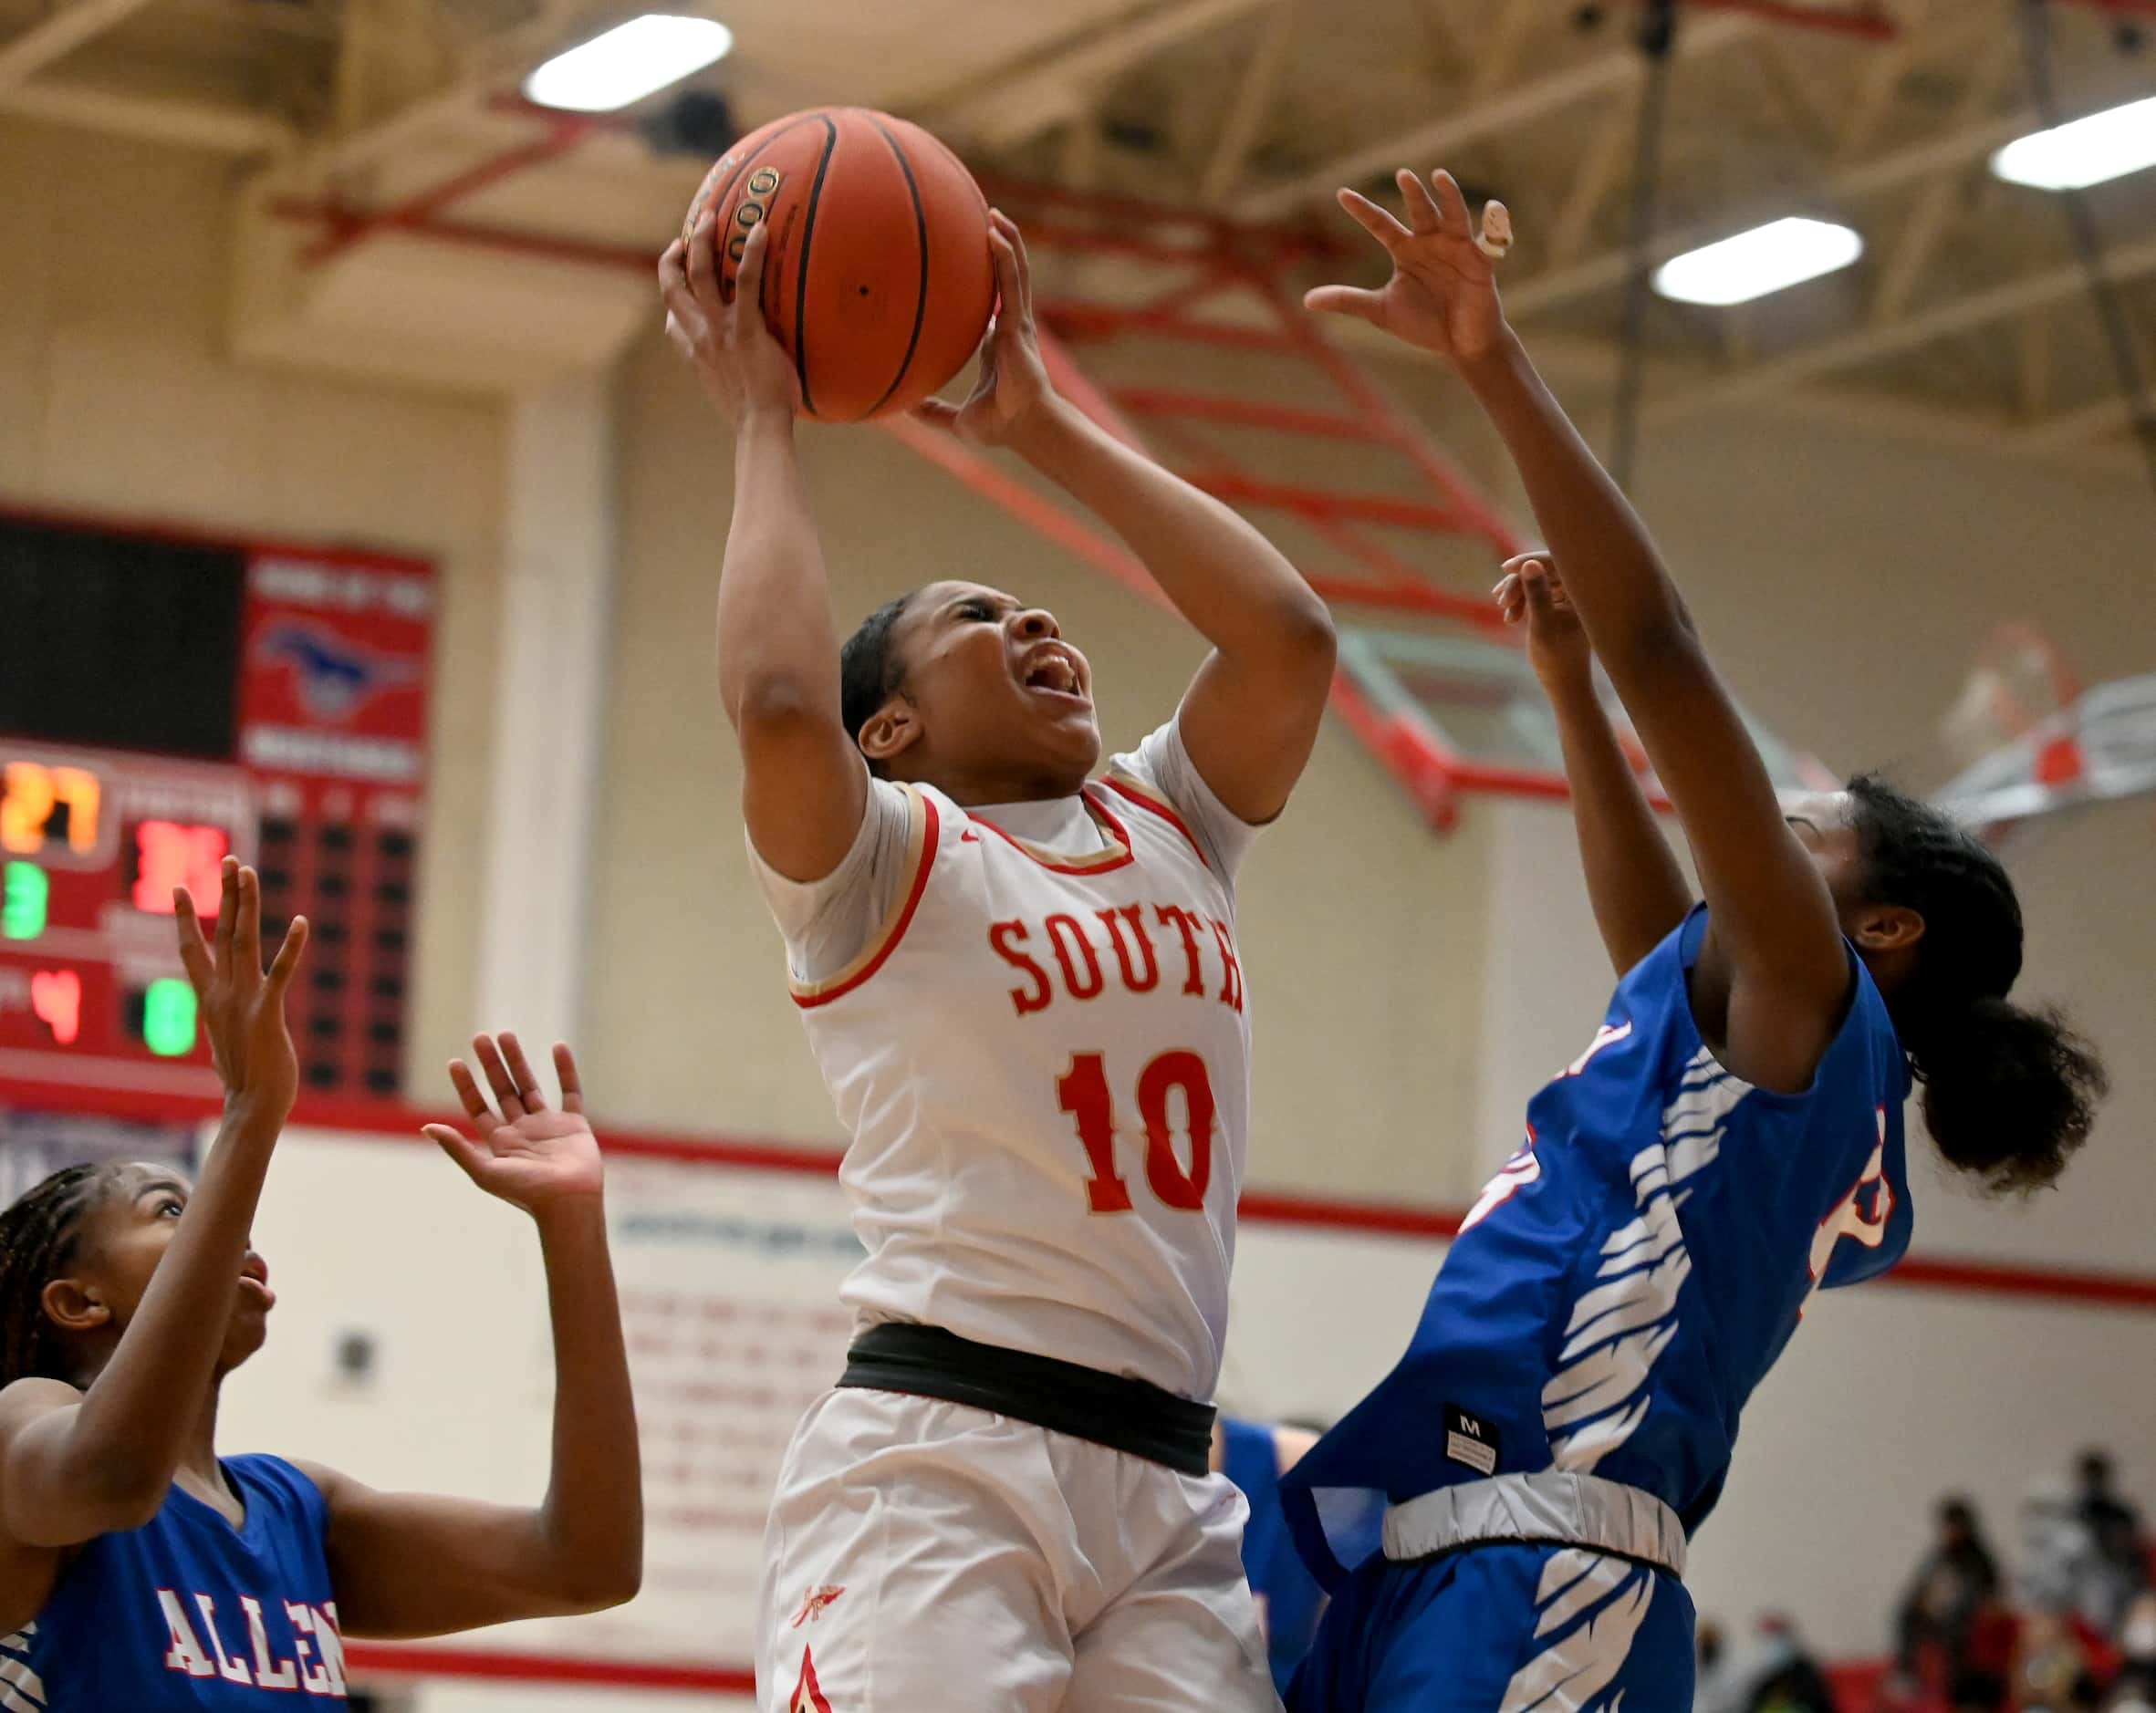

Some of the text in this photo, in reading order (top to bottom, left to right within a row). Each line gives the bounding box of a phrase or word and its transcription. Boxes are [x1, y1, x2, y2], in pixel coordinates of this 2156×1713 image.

[987, 903, 1244, 1017] SOUTH
[1055, 1048, 1218, 1216] 10
[1460, 1413, 1481, 1438] M
[156, 1588, 348, 1697] ALLEN
